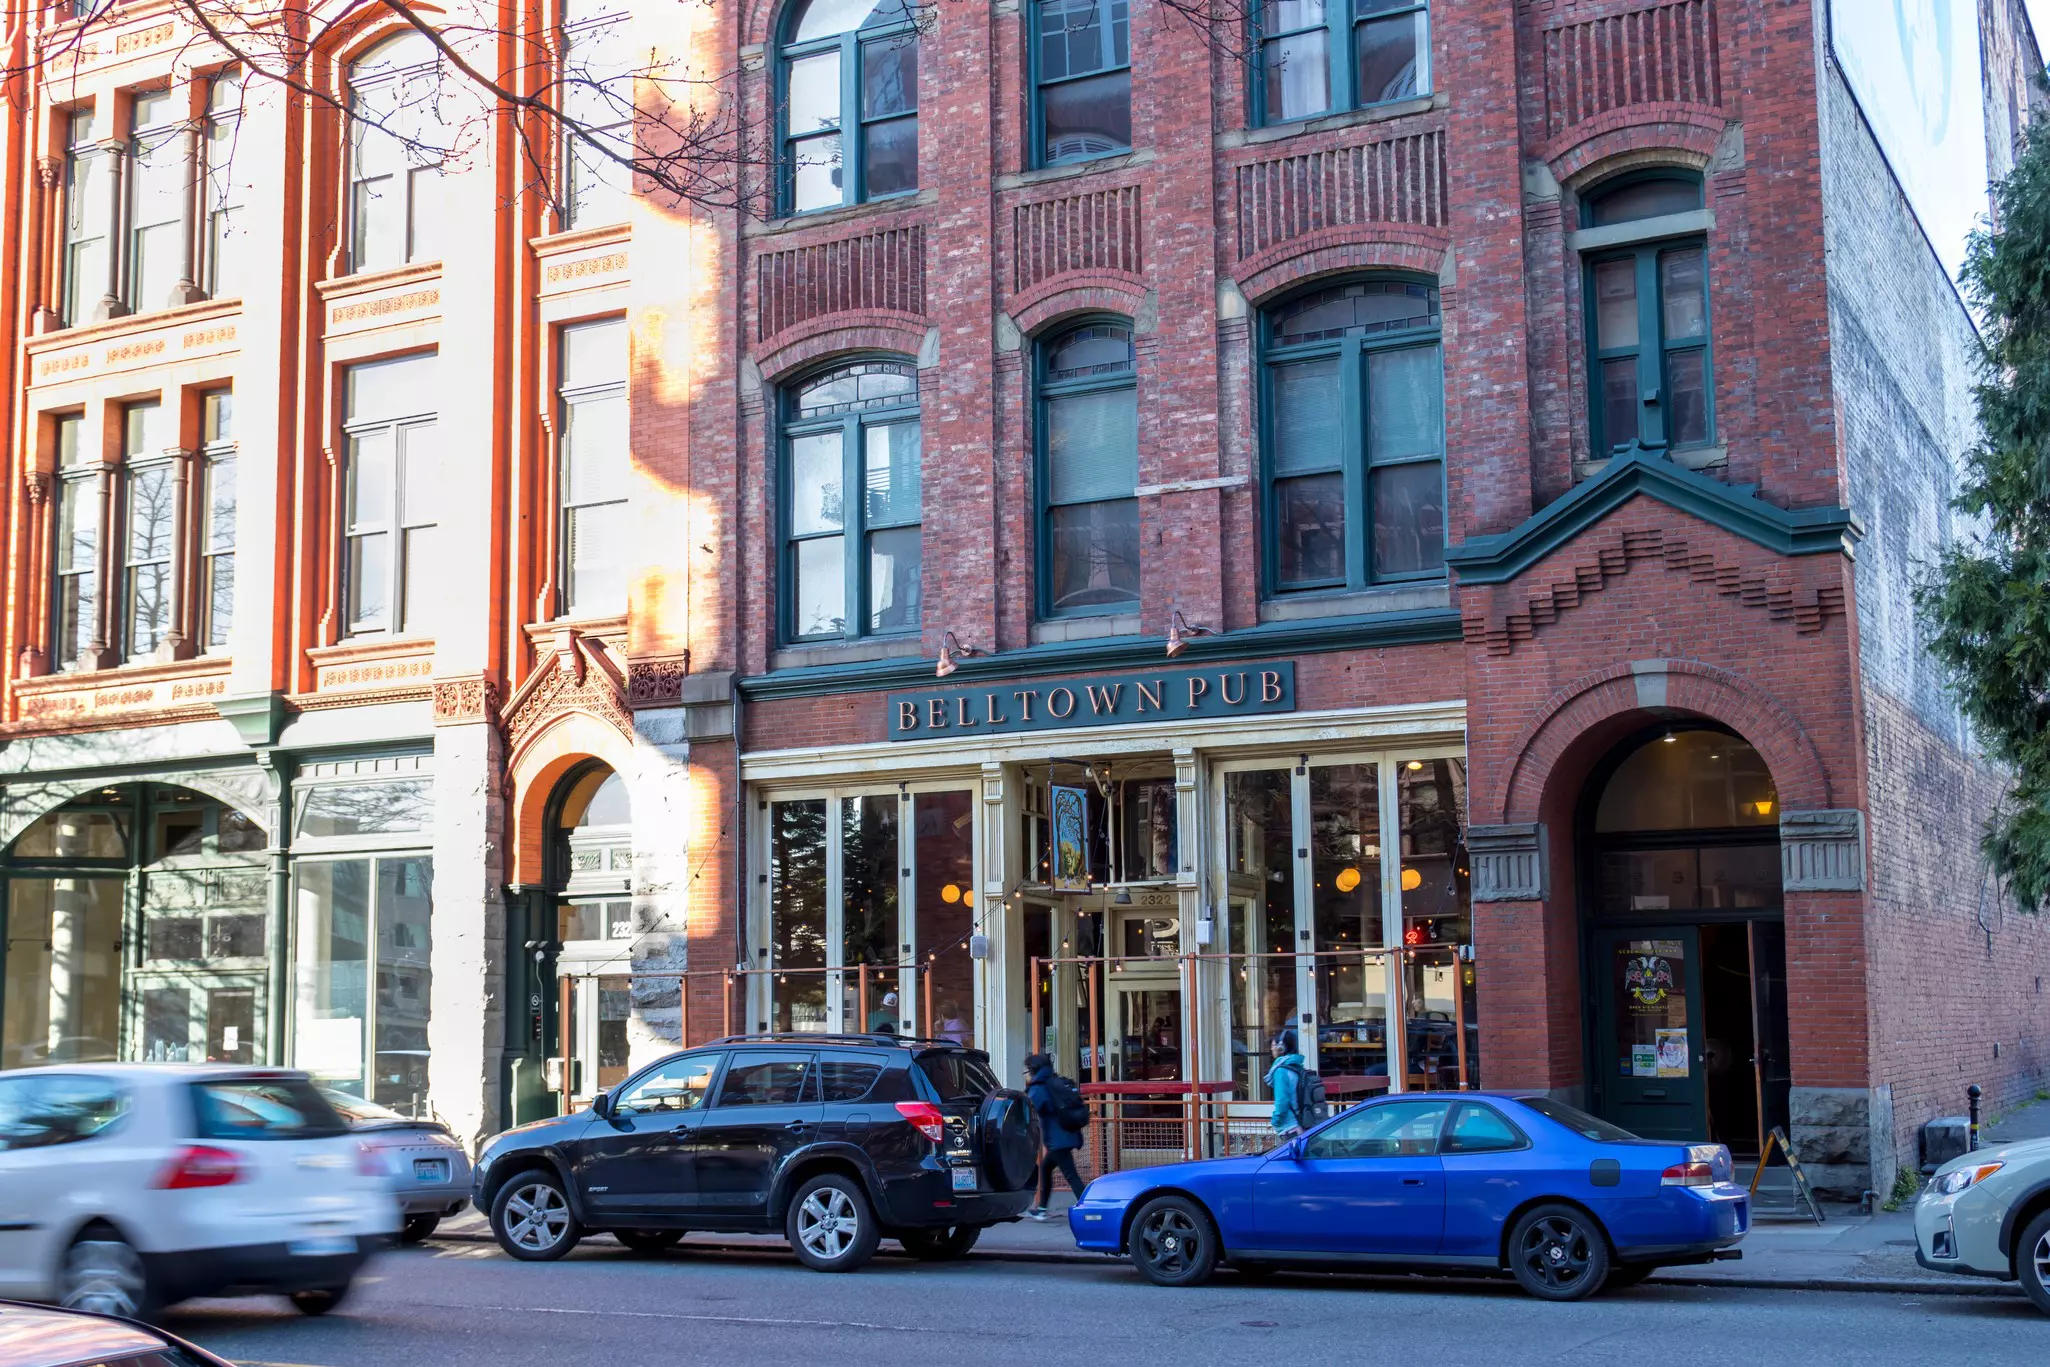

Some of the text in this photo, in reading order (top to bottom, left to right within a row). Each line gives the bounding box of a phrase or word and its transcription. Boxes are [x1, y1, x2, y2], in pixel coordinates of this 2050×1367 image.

[896, 671, 1282, 731] BELLTOWN PUB
[1141, 894, 1171, 905] 2322
[1083, 1054, 1105, 1067] ON
